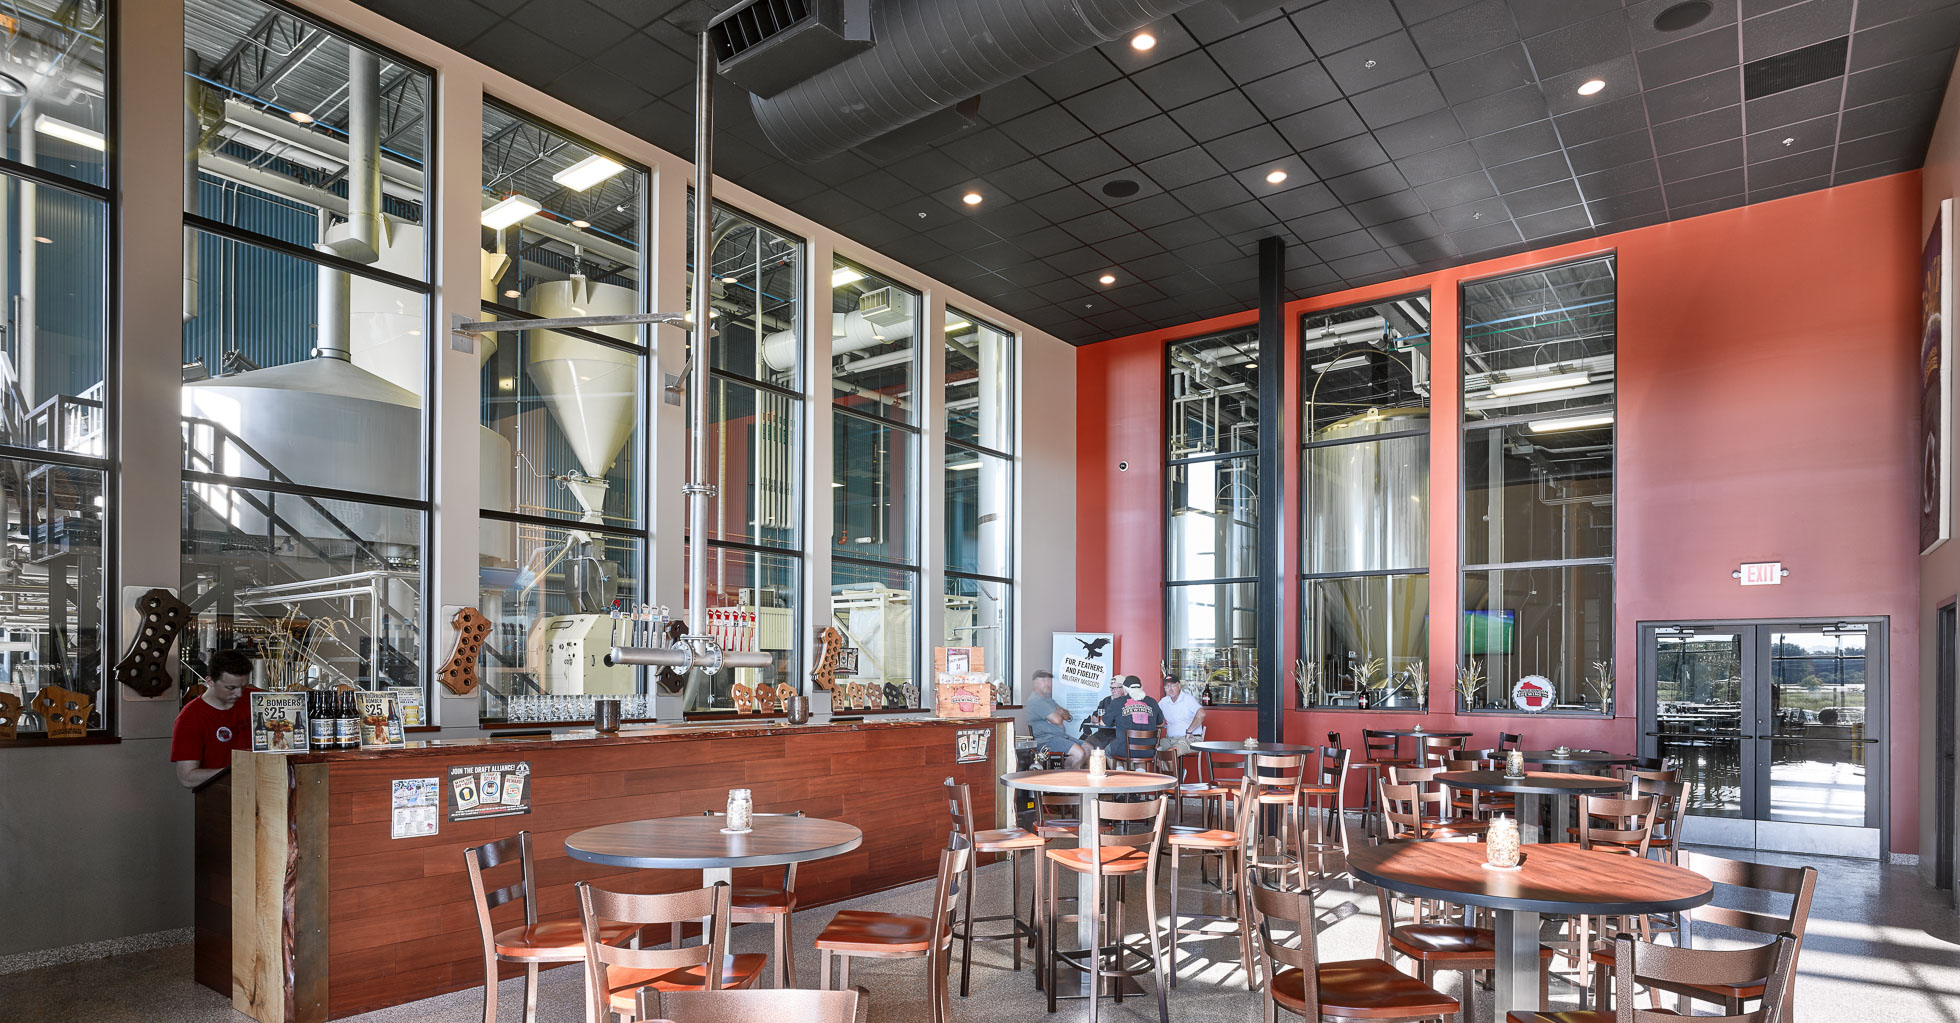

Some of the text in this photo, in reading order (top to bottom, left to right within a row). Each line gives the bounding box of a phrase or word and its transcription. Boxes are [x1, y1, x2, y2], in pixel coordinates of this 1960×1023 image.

[1747, 564, 1776, 583] EXIT
[1065, 657, 1104, 673] FUR, FEATHERS,
[1065, 666, 1100, 681] AND FIDELITY
[1062, 674, 1101, 689] MILITARY MASCOTS
[257, 695, 301, 707] 2 BOMBERS
[264, 706, 286, 720] $25
[365, 703, 384, 717] $25
[450, 764, 516, 776] JOIN THE DRAFT ALLIANCE!
